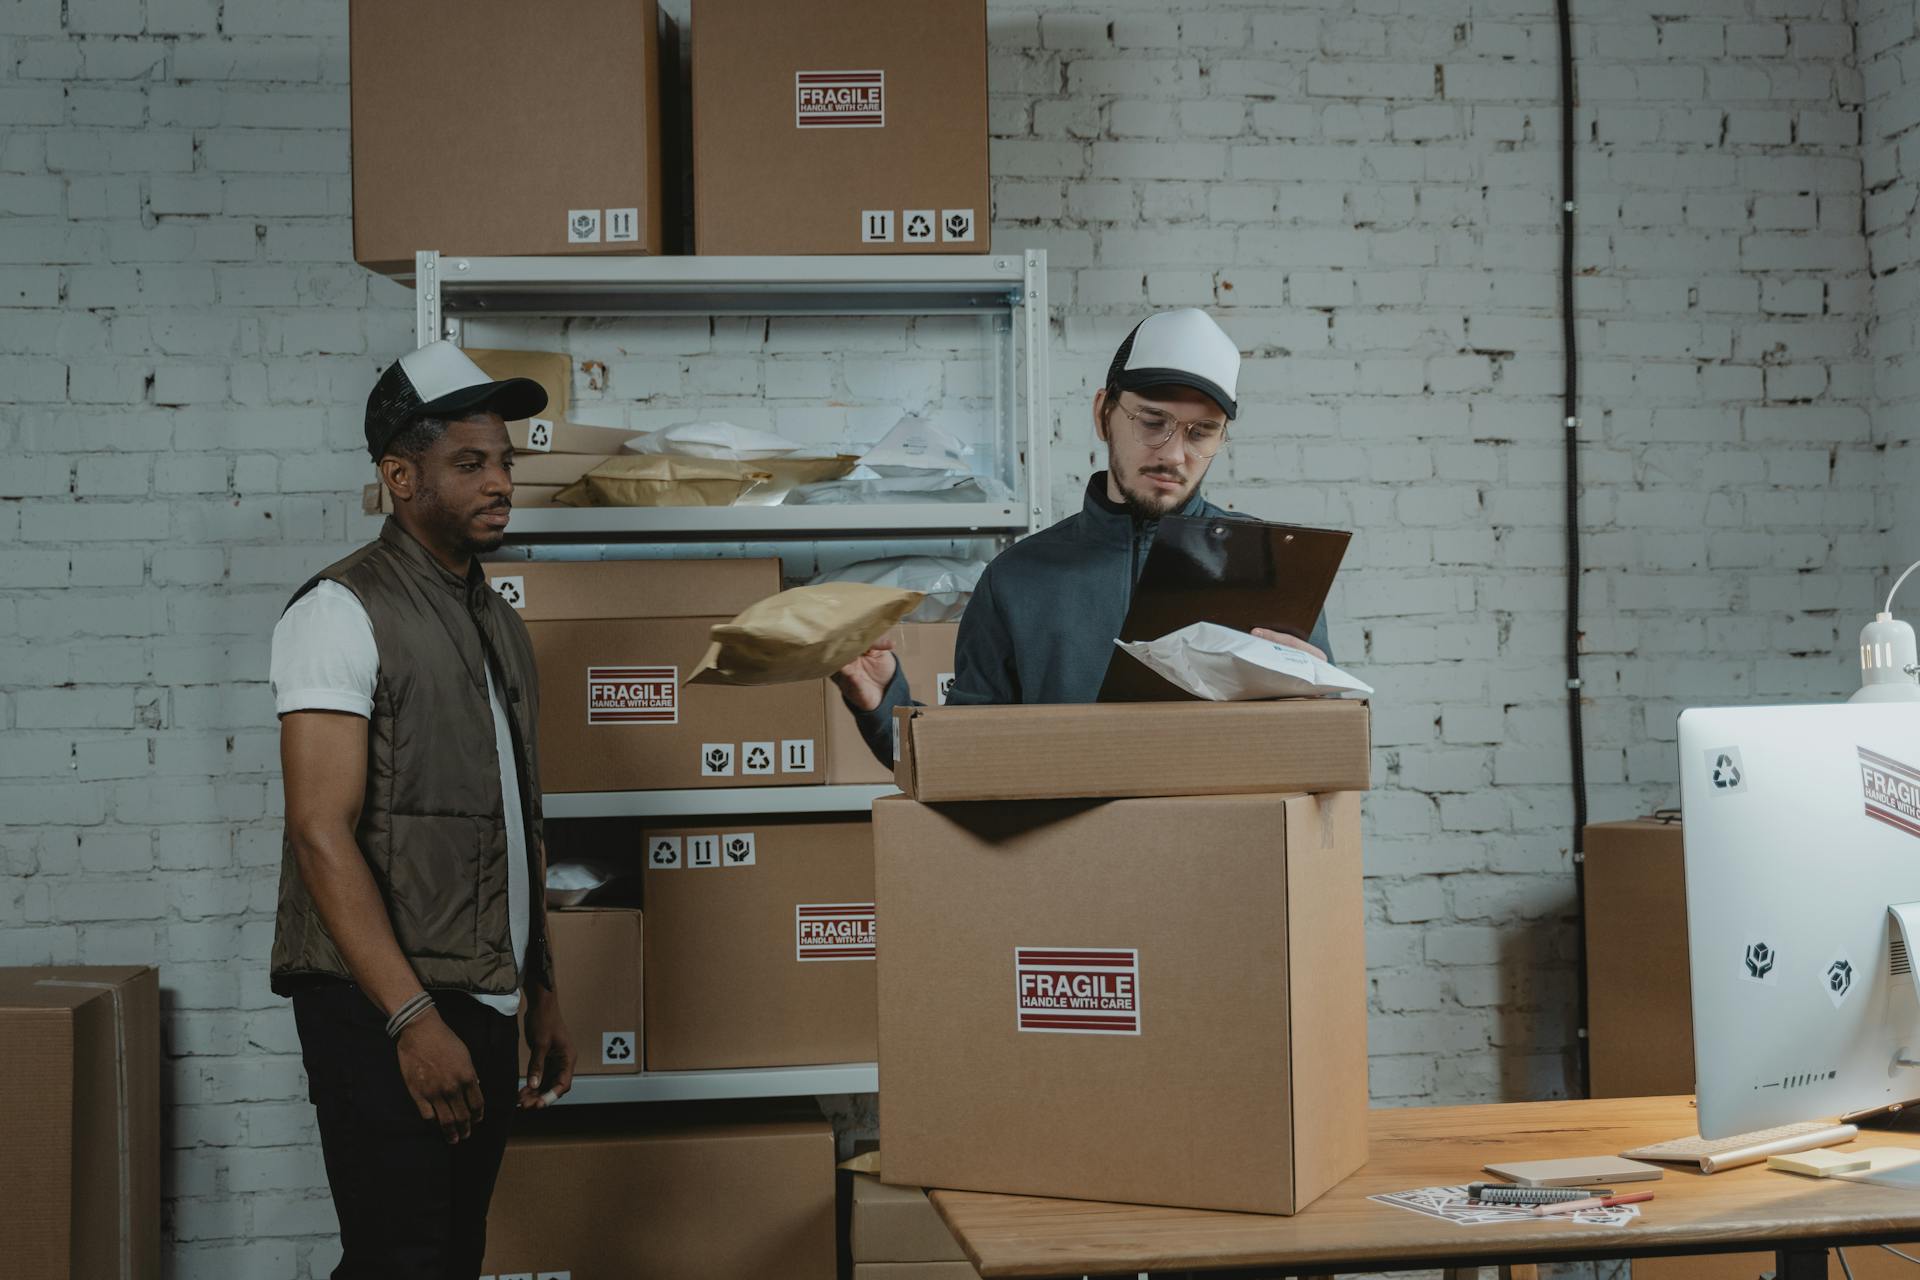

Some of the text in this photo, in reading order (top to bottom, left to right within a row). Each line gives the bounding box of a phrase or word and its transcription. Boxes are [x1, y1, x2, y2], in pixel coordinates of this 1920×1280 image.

[800, 88, 880, 104] FRAGILE
[800, 104, 833, 112] HANDLE
[857, 103, 880, 111] CARE
[591, 684, 673, 700] FRAGILE
[592, 700, 626, 708] HANDLE
[649, 699, 673, 707] CARE
[1862, 767, 1920, 810] FRAGIL
[1865, 787, 1896, 808] HANDLE
[1896, 799, 1916, 817] WITH
[800, 921, 876, 937] FRAGILE
[801, 936, 834, 945] HANDLE
[835, 936, 856, 944] WITH
[1021, 974, 1132, 998] FRAGILE
[1022, 997, 1132, 1009] HANDLE WITH CARE
